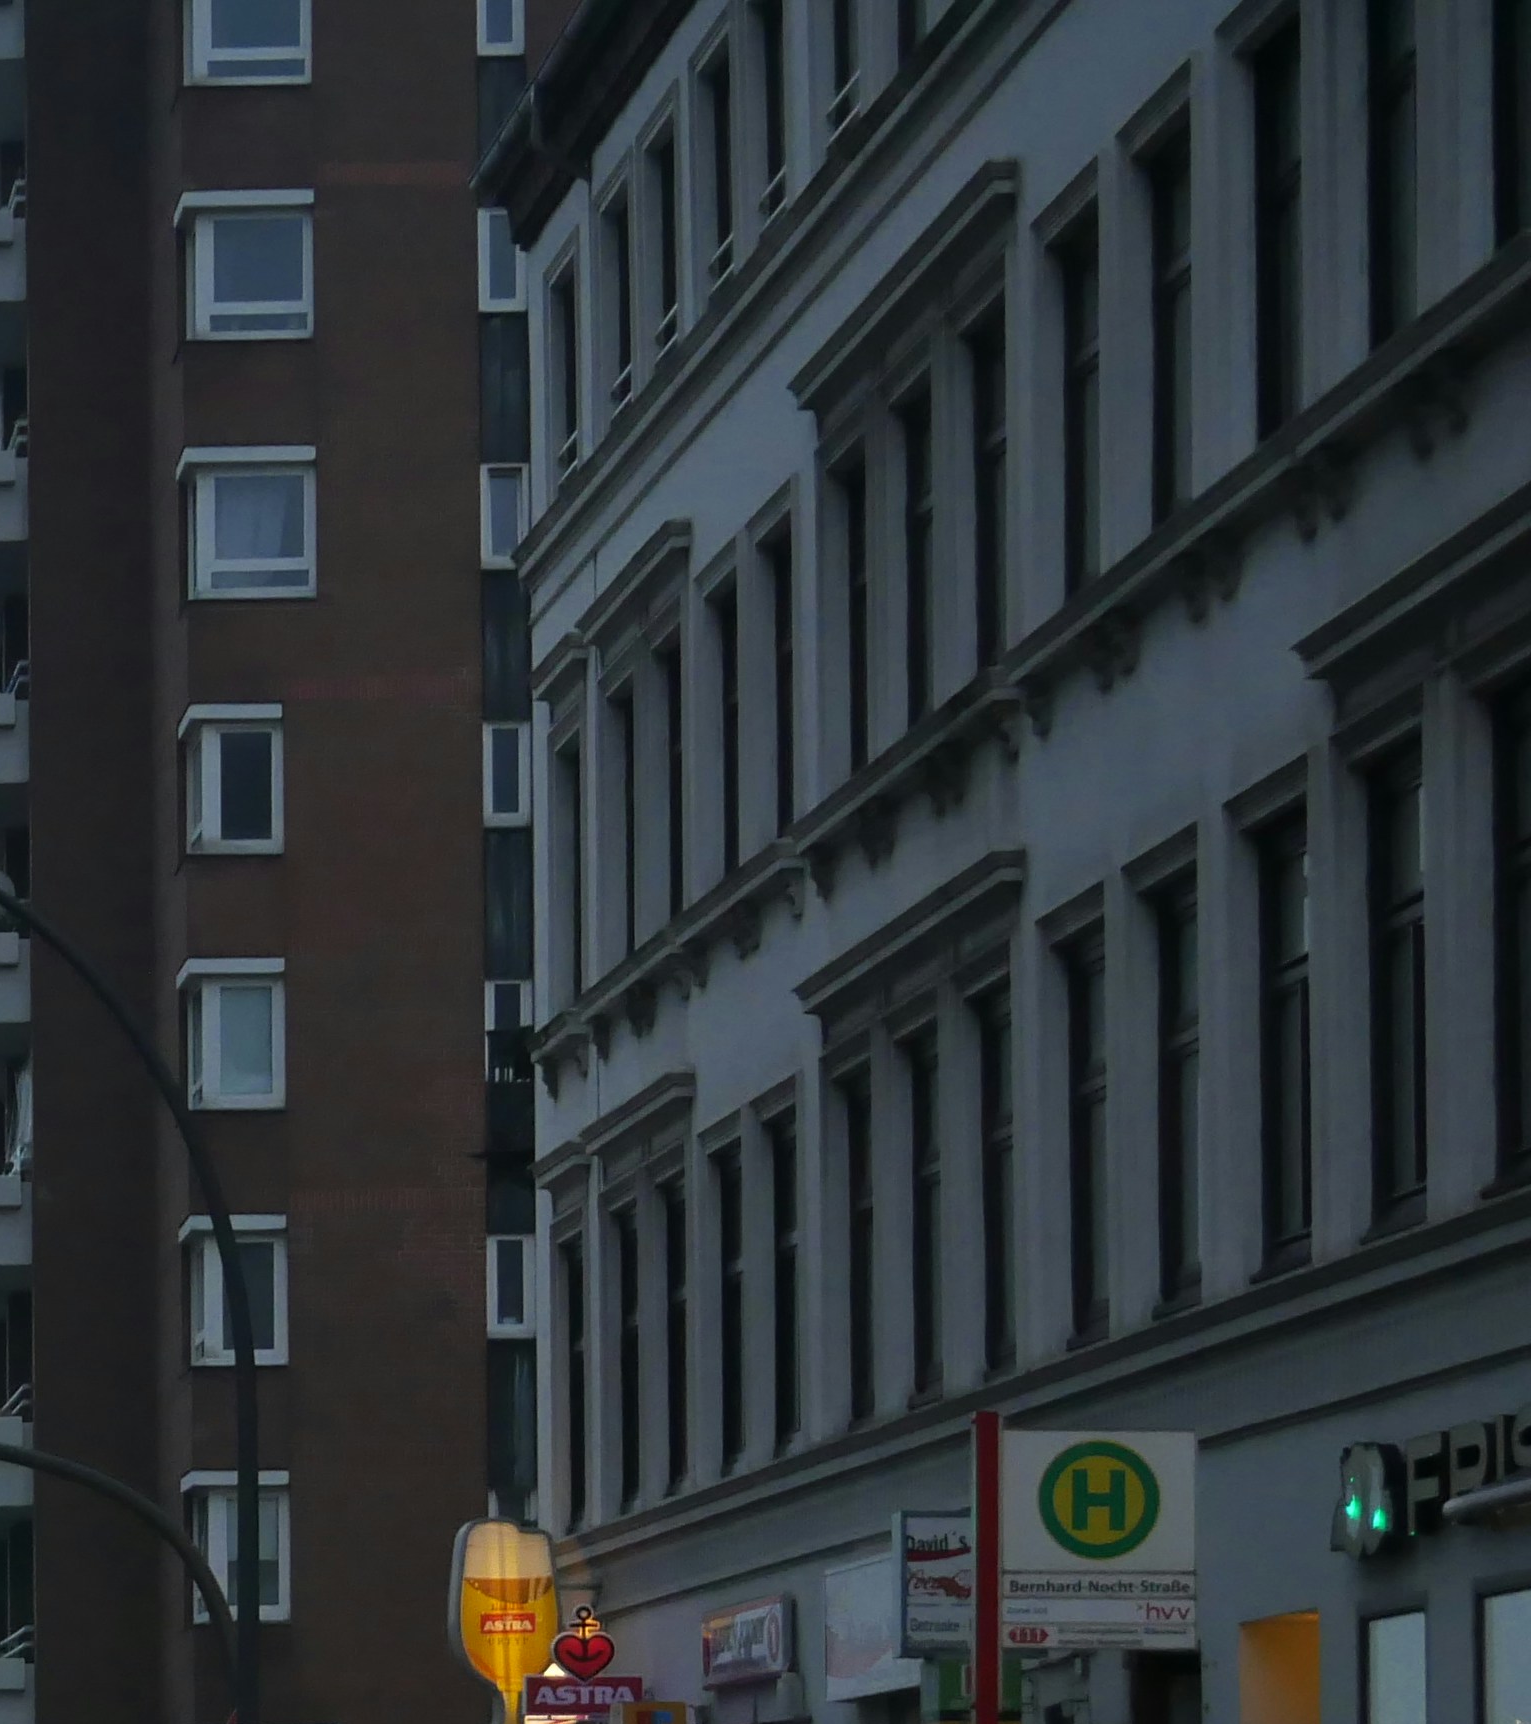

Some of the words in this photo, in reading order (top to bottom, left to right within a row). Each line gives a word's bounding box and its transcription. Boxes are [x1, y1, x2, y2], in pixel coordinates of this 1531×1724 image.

[1072, 1469, 1125, 1530] H
[1146, 1602, 1190, 1620] hvv
[482, 1619, 534, 1631] ASTRA
[535, 1686, 635, 1705] ASTRA
